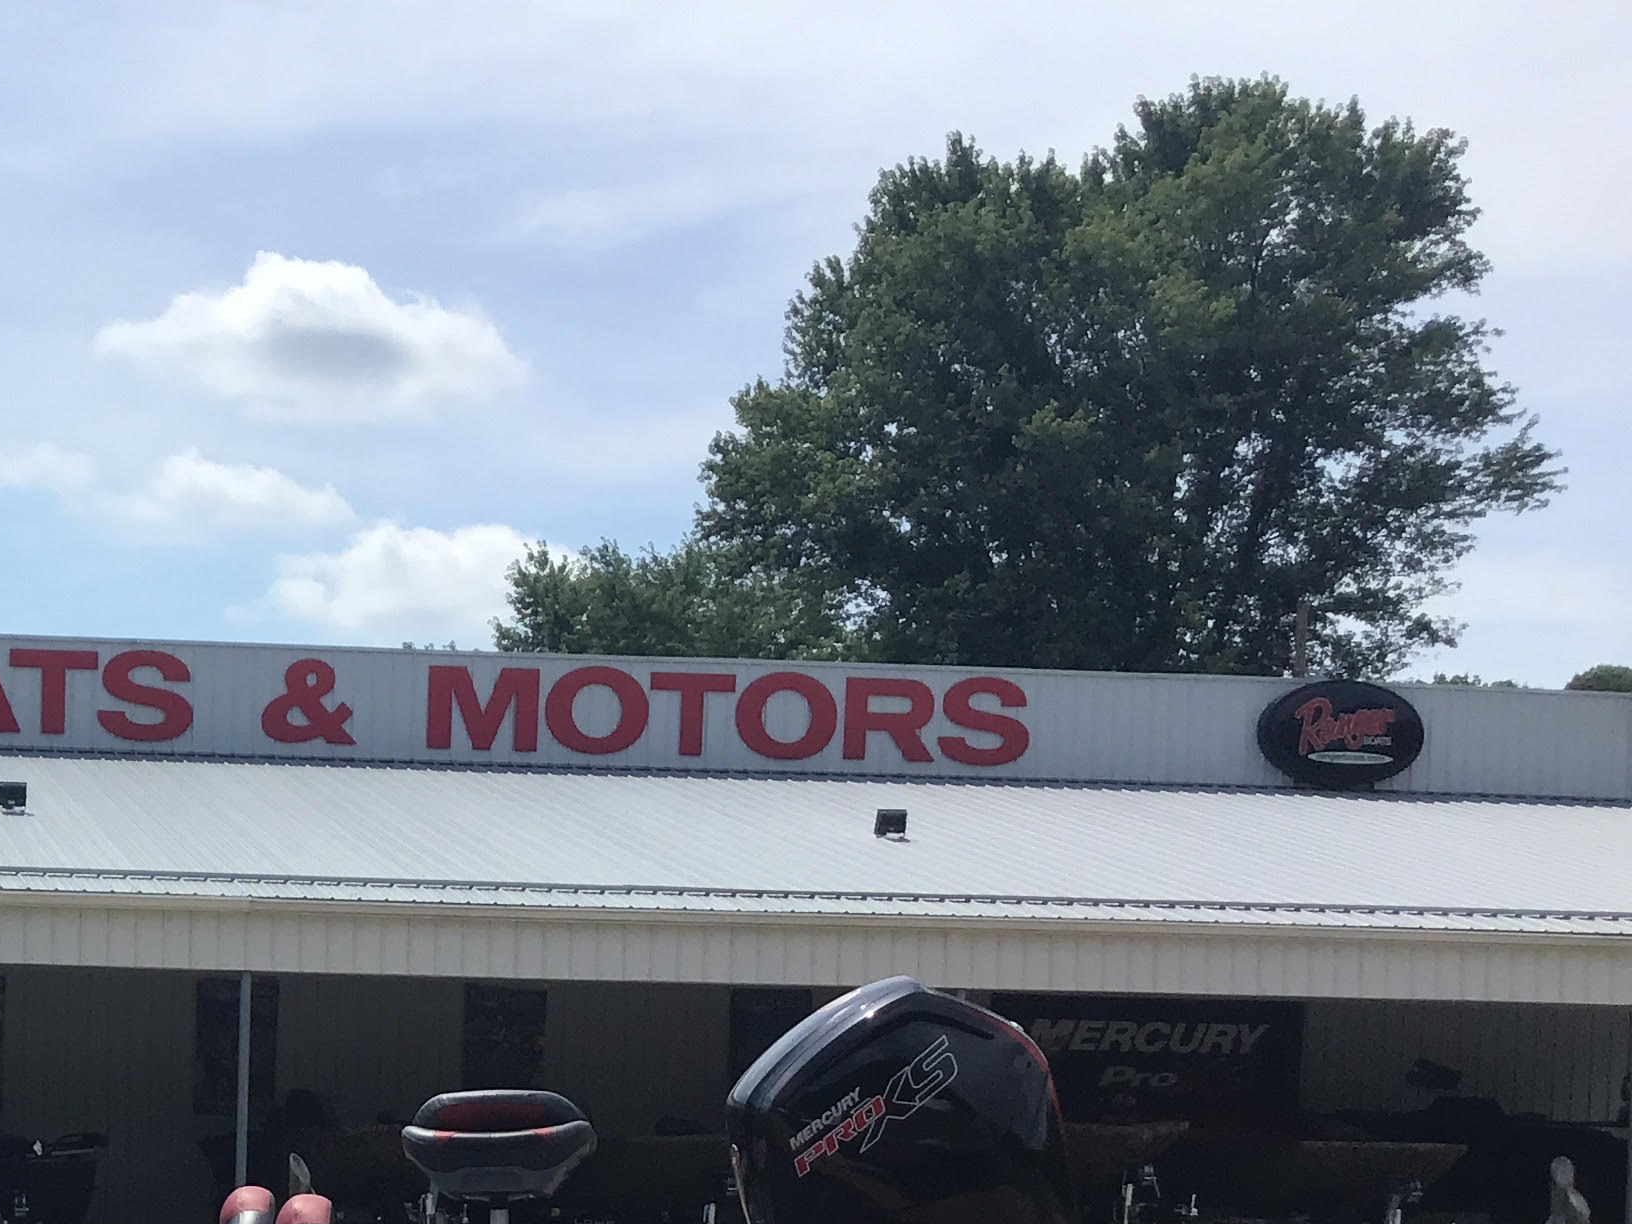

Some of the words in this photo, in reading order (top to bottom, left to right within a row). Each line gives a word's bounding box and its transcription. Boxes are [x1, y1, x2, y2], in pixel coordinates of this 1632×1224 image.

[261, 657, 357, 746] &
[425, 664, 1032, 767] MOTORS
[1029, 1018, 1270, 1055] MERCURY
[1098, 1066, 1178, 1087] Pro
[789, 1086, 862, 1150] MERCURY
